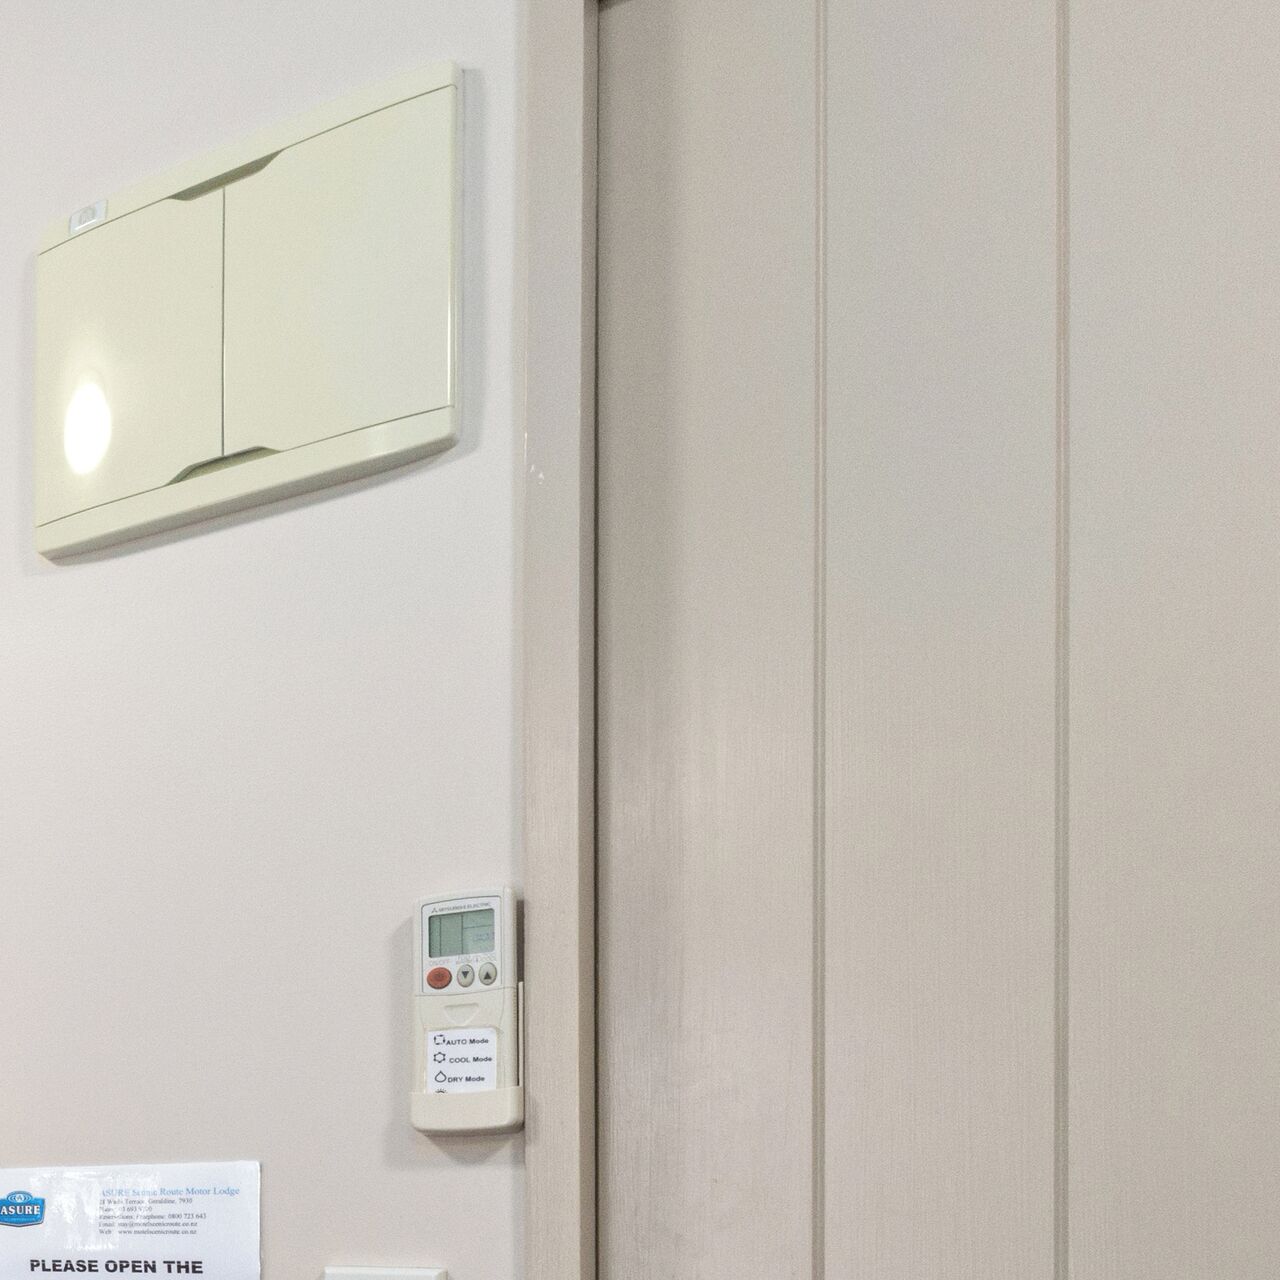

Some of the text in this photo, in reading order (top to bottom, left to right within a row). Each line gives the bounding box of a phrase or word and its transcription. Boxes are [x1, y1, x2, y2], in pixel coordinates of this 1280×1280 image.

[160, 1188, 183, 1196] Route
[186, 1187, 210, 1195] Motor
[213, 1186, 240, 1196] Lodge
[0, 1205, 41, 1215] ASURE
[30, 1259, 203, 1274] PLEASE OPEN THE
